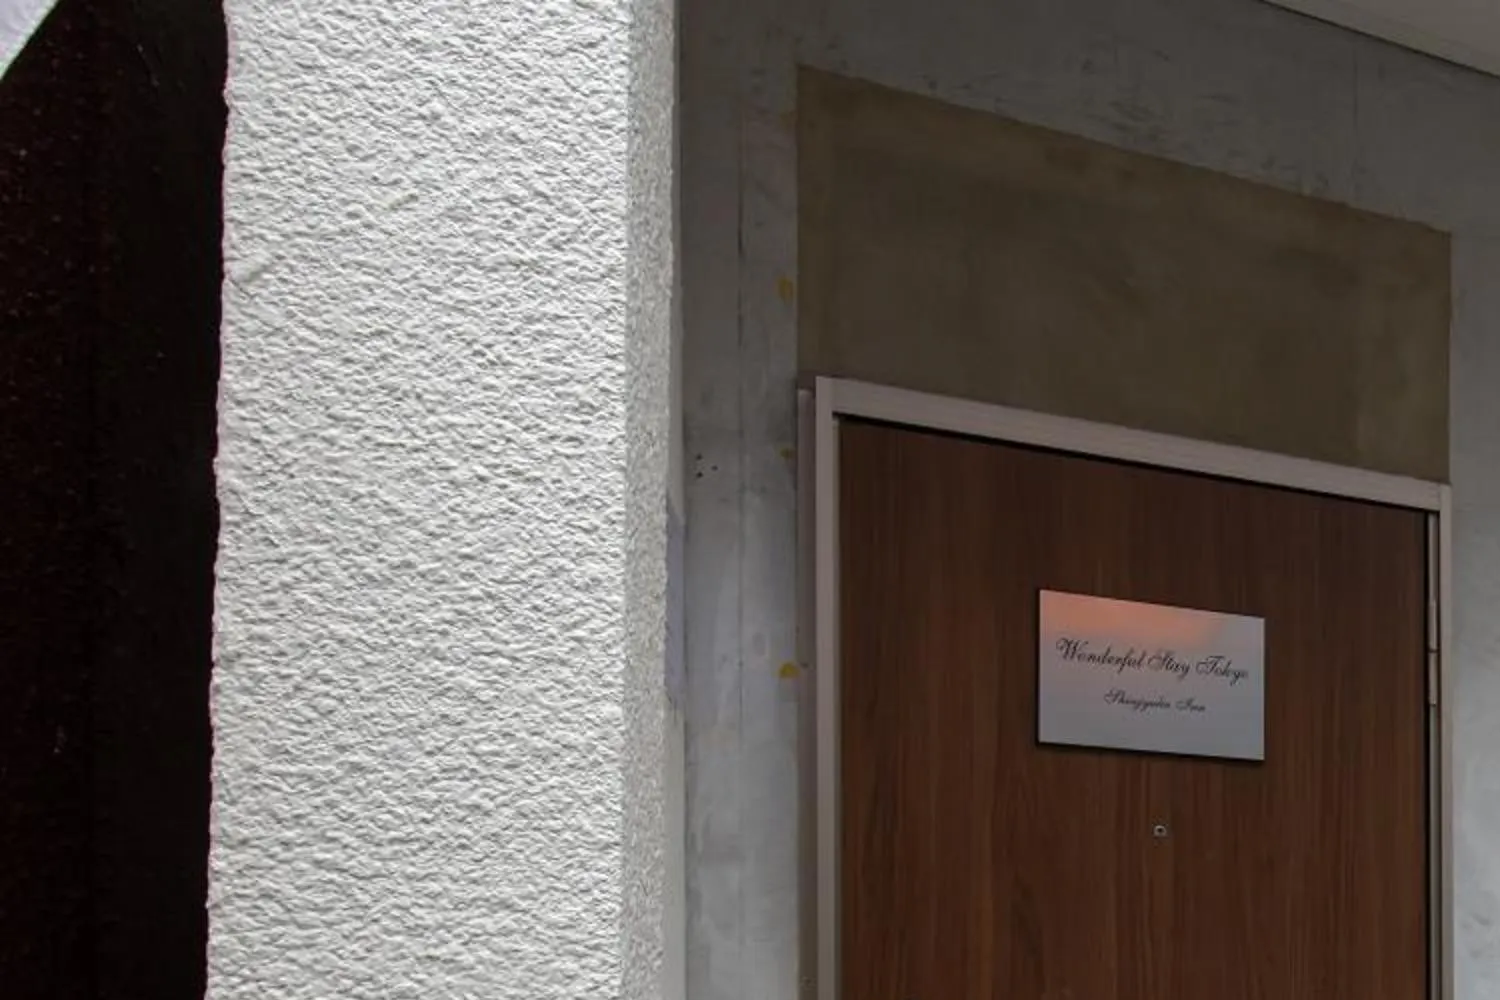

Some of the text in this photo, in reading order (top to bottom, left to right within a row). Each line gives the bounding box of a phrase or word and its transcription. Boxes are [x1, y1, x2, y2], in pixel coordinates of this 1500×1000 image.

[1056, 637, 1249, 686] Wonderful Stay Tokyo
[1175, 698, 1206, 713] Inn
